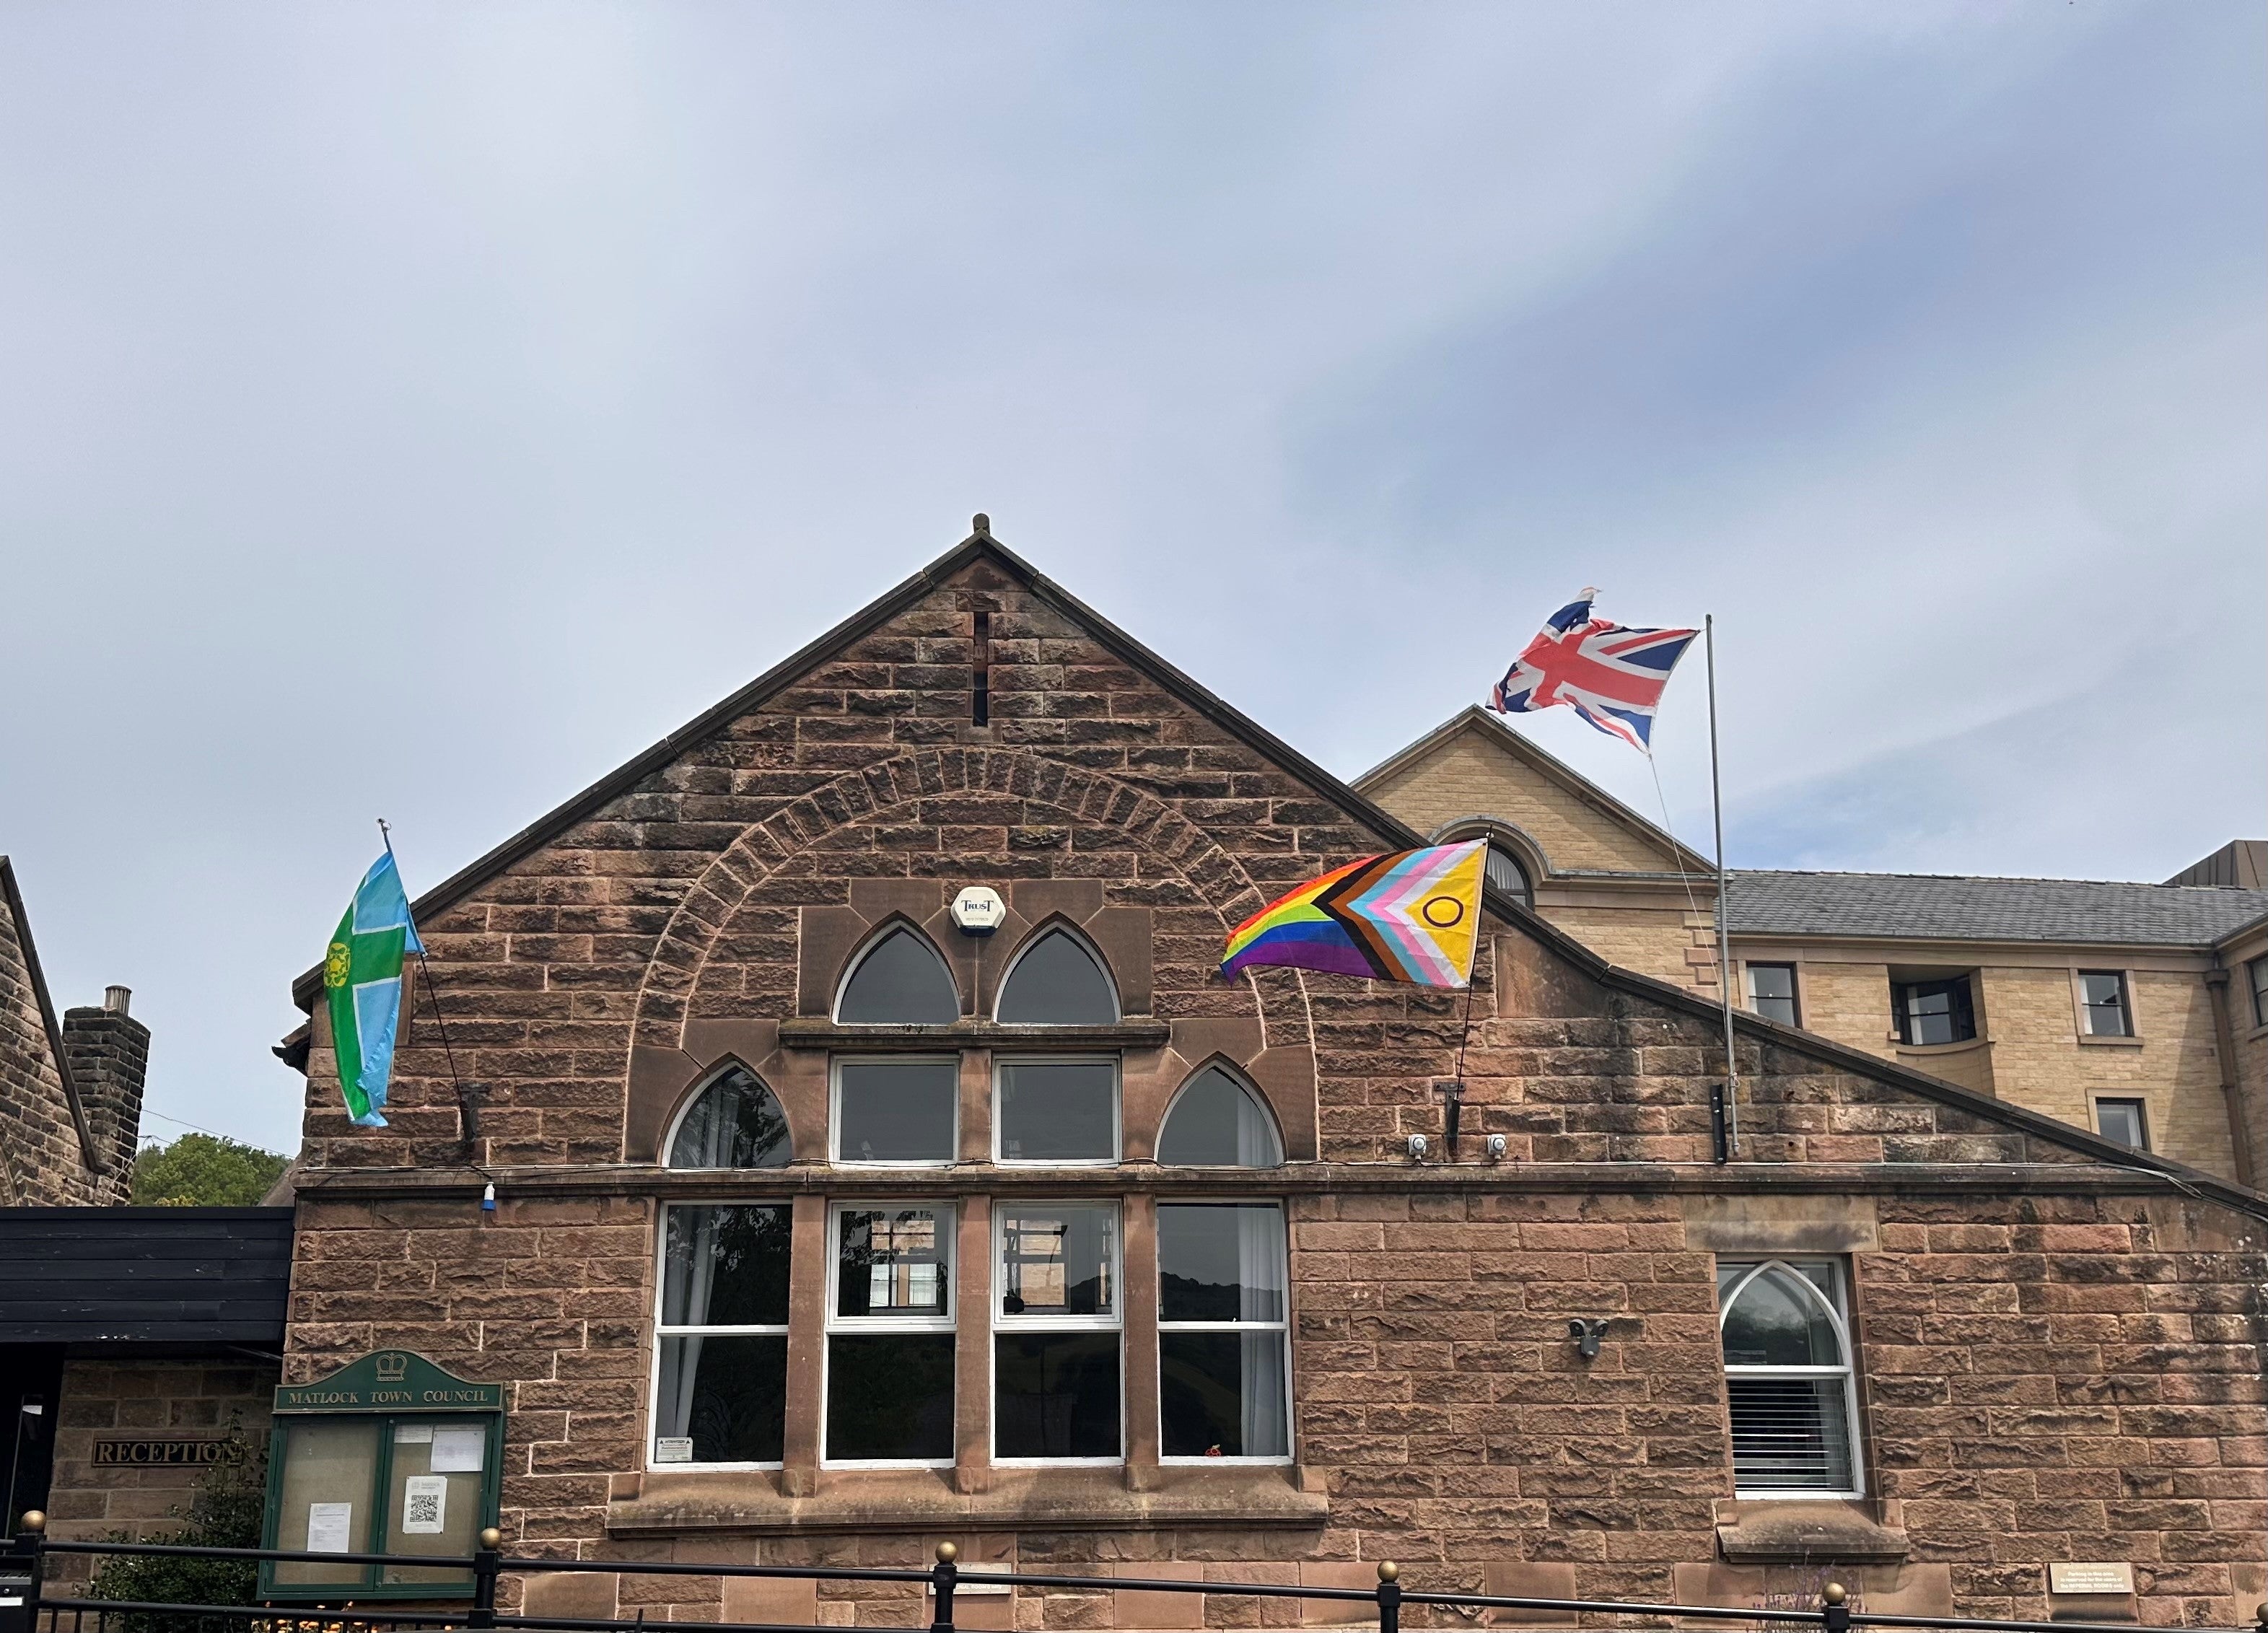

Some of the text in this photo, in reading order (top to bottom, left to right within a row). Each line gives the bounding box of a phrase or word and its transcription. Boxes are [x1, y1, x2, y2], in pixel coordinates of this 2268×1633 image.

[960, 899, 994, 911] TRUST
[289, 1390, 488, 1404] MATLOCK TOWN COUNCIL
